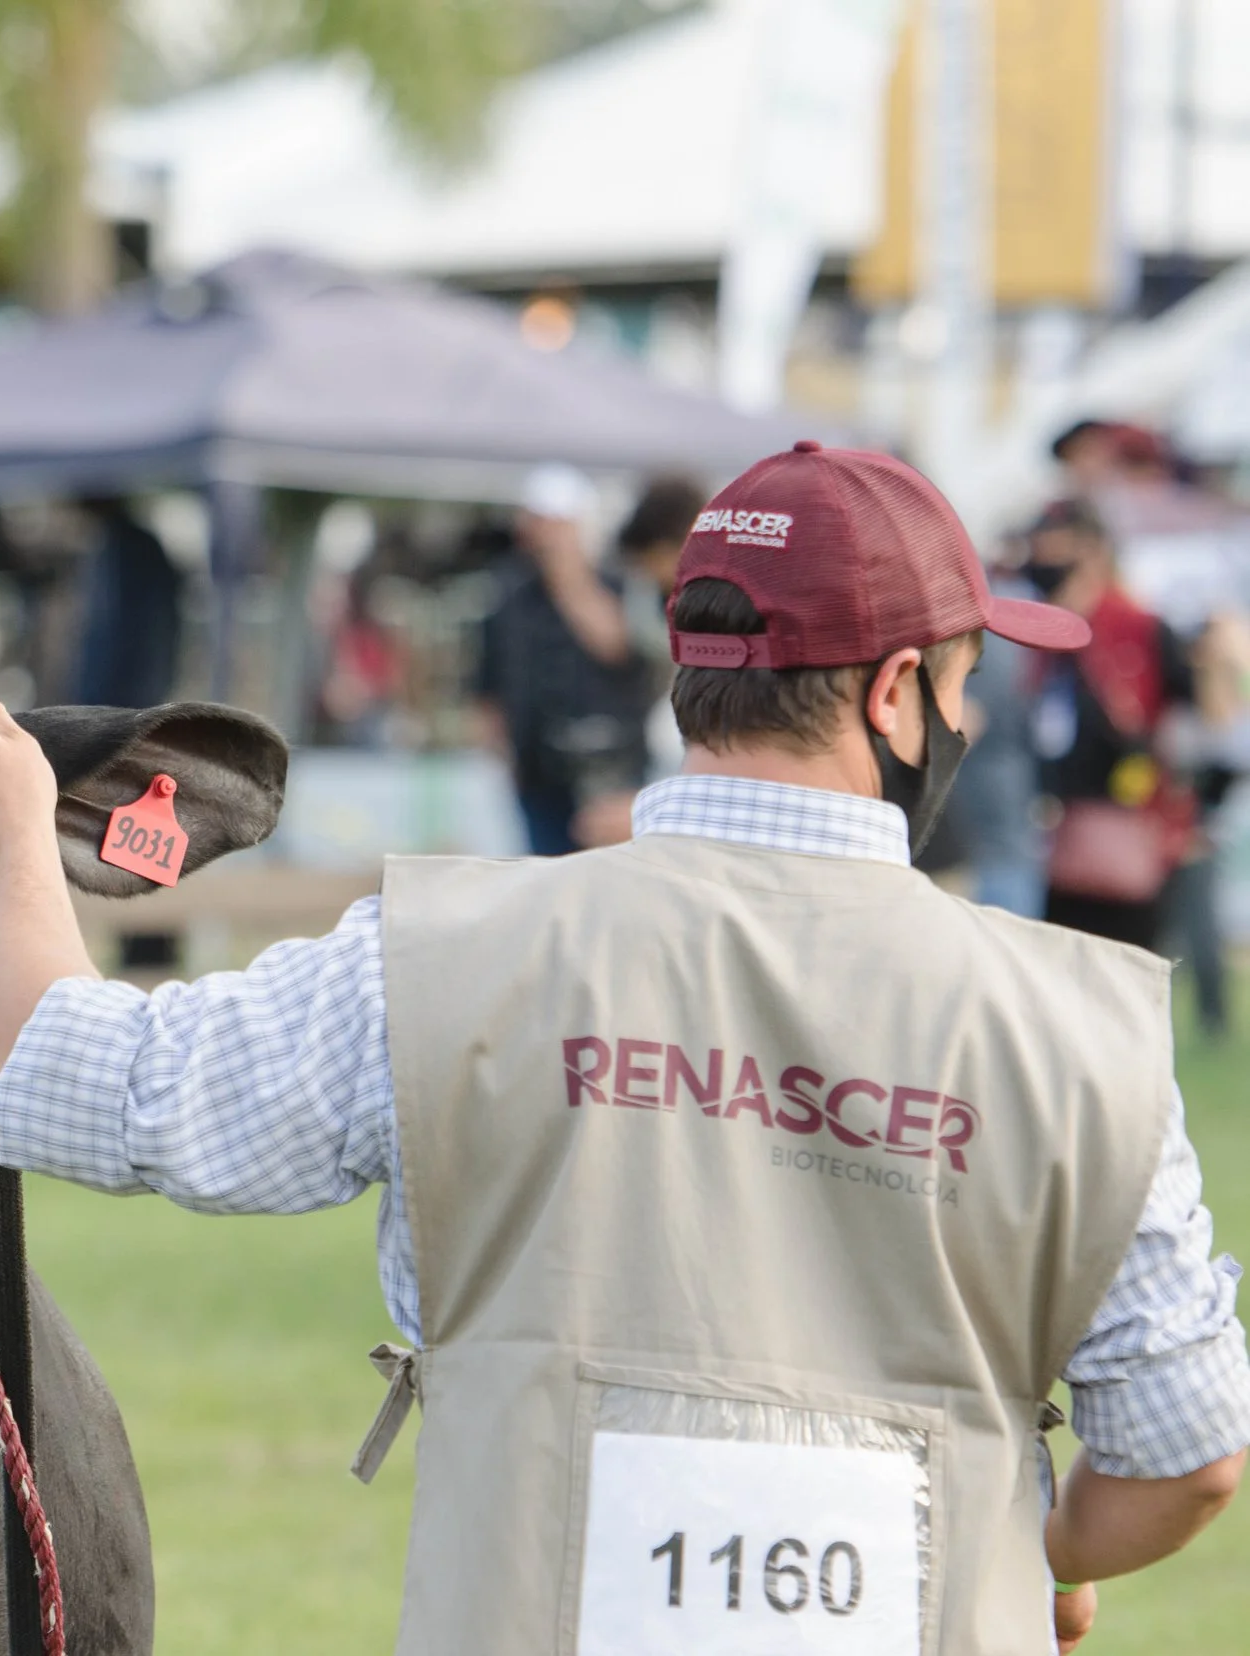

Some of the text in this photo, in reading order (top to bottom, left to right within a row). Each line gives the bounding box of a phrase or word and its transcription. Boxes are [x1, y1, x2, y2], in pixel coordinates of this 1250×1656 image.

[111, 816, 176, 869] 9031
[562, 1036, 981, 1174] RENASCER
[771, 1146, 959, 1208] BIOTECNOLOA
[651, 1531, 863, 1616] 1160
